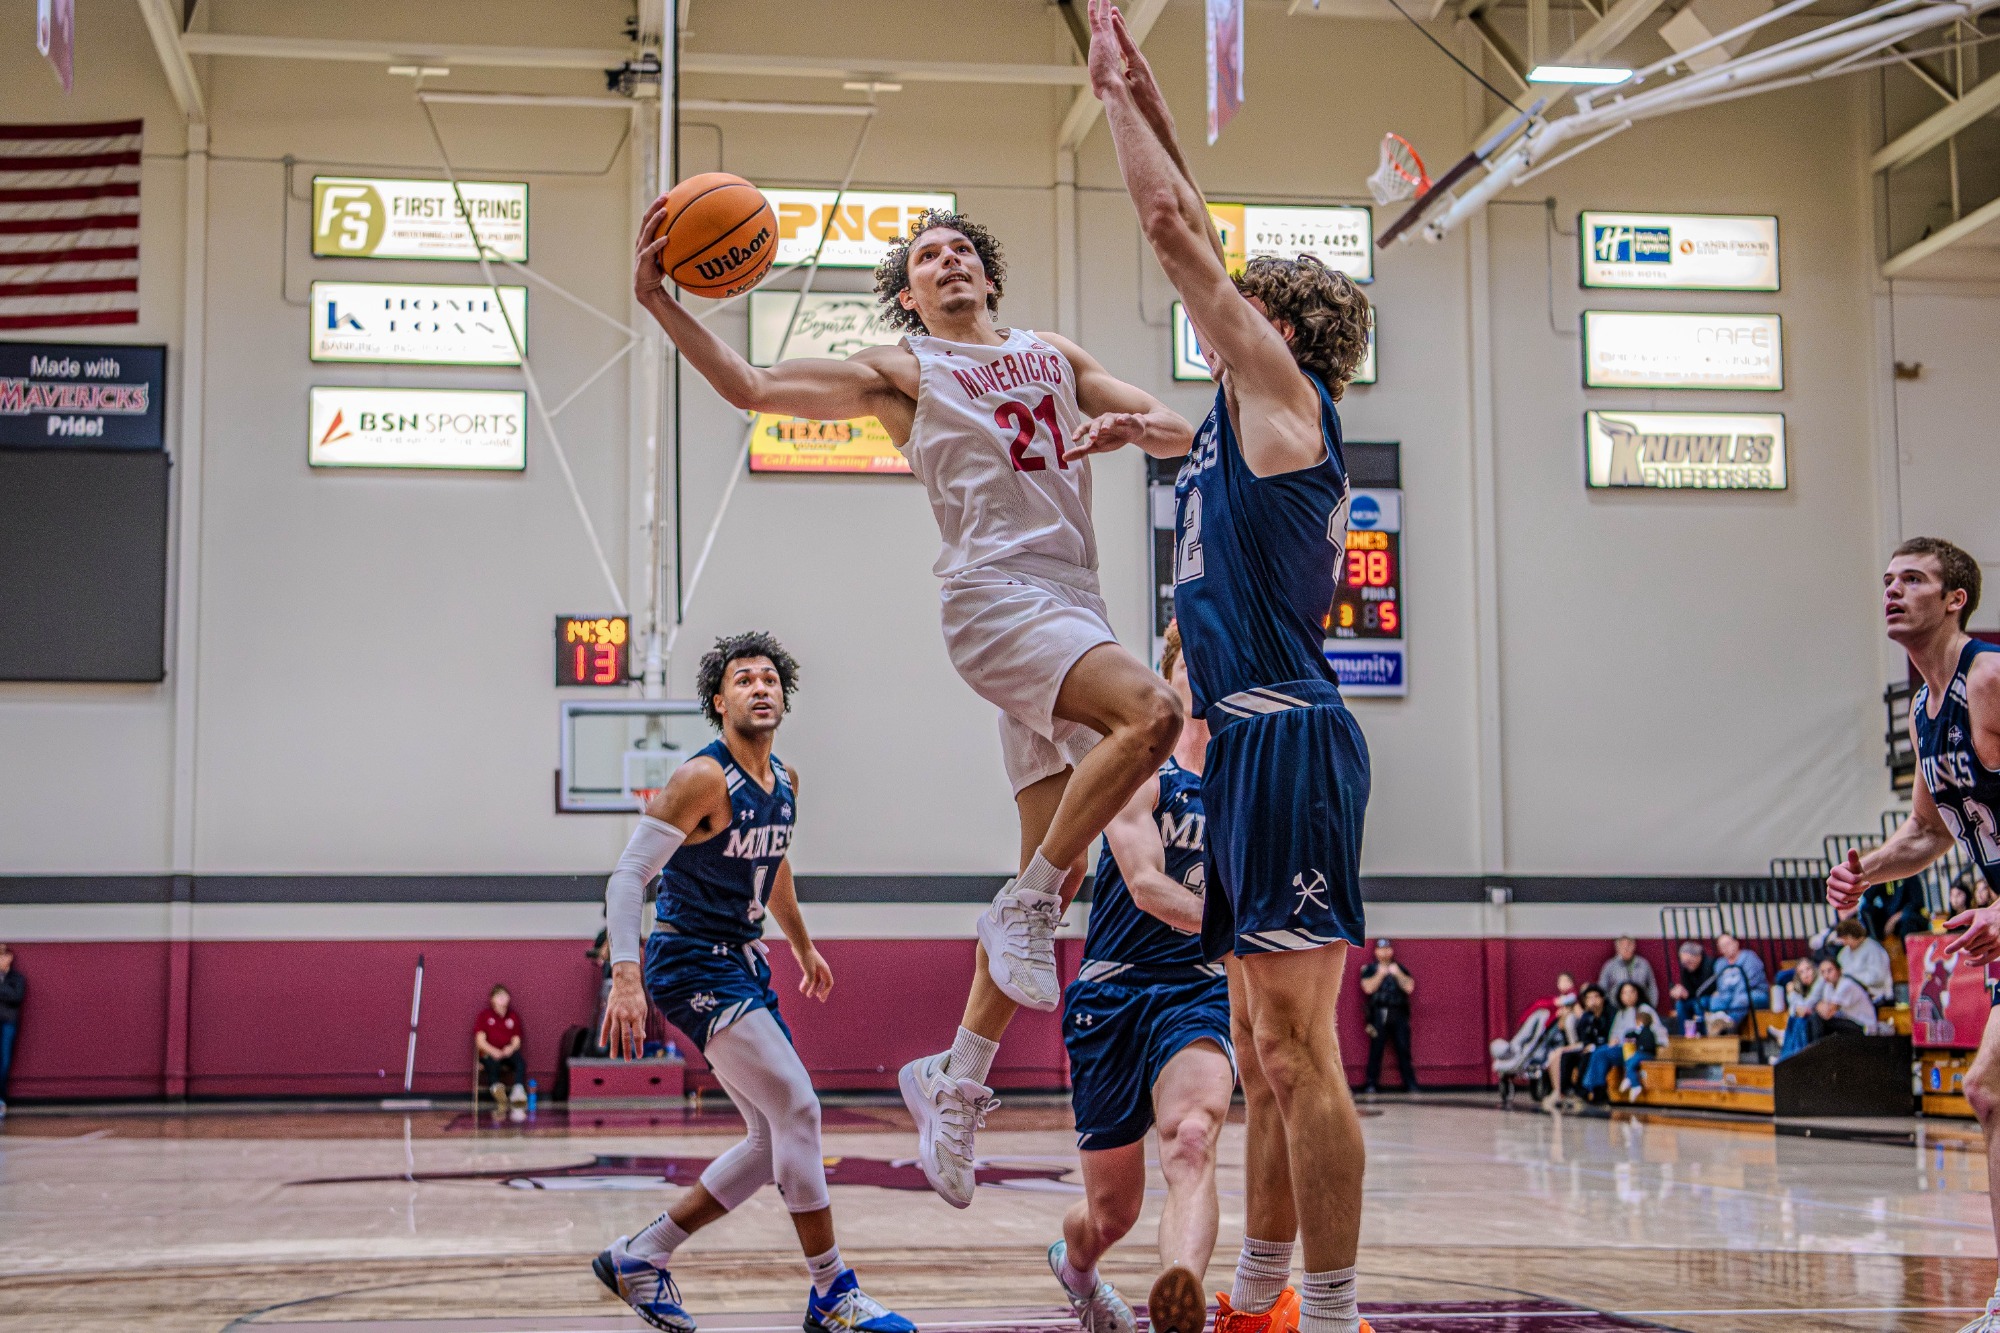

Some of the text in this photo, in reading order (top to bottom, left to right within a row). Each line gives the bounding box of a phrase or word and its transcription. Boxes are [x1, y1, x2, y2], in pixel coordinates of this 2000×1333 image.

[392, 197, 522, 220] FIRST STRING
[695, 227, 771, 280] Wilson
[1697, 326, 1770, 348] CAFE
[30, 355, 121, 378] Made with
[952, 352, 1062, 400] MAVERICKS
[0, 379, 147, 412] MAVERICKS
[47, 416, 104, 437] Pride!
[360, 412, 518, 435] BSN SPORTS
[778, 422, 851, 441] TEXAS
[994, 394, 1069, 473] 21
[1610, 433, 1774, 486] KNOWLES
[1174, 487, 1205, 588] 2
[1348, 550, 1388, 585] 38
[567, 619, 626, 644] 14:58
[576, 645, 615, 683] 13
